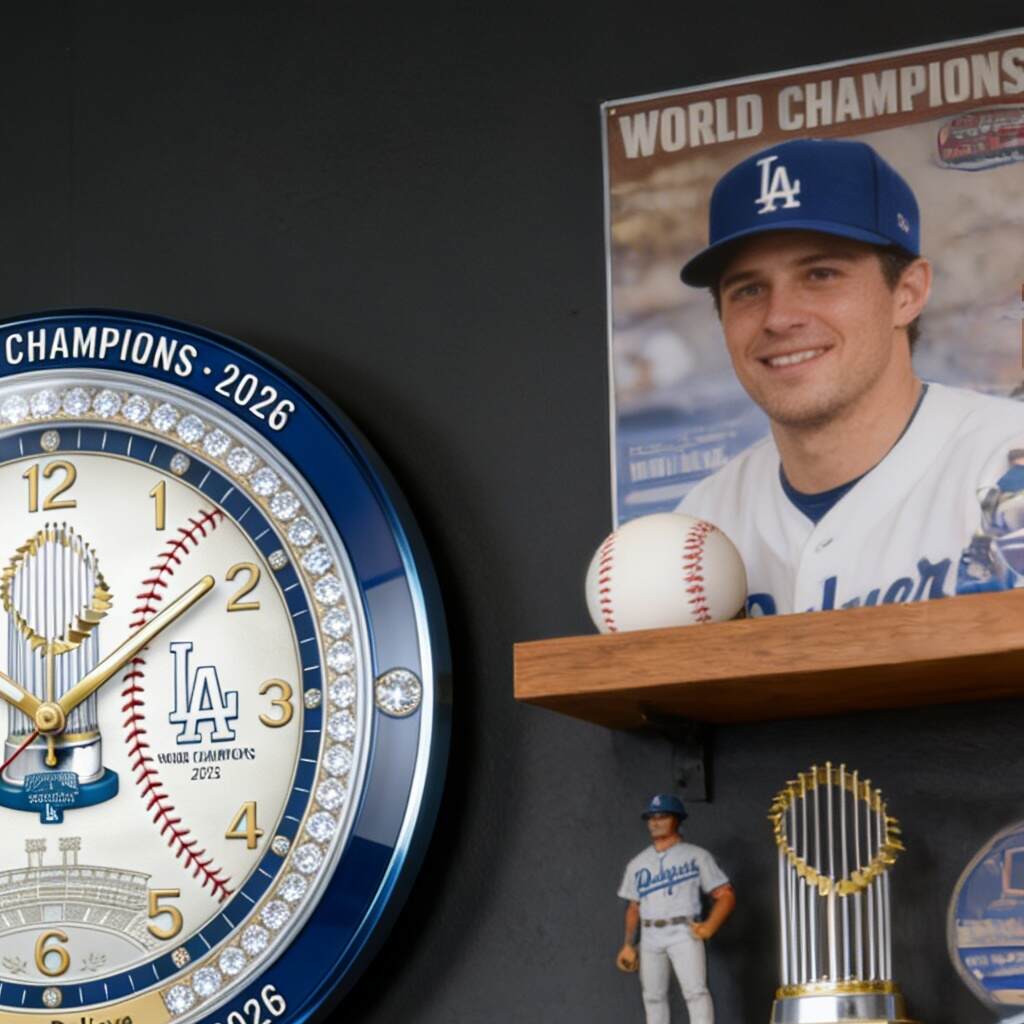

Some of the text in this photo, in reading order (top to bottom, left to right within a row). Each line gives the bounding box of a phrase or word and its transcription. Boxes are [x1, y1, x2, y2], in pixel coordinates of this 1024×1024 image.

[619, 48, 1024, 158] WORLD CHAMPIONS
[755, 155, 801, 214] LA
[5, 326, 198, 377] CHAMPIONS
[215, 364, 295, 431] 2026
[22, 460, 77, 513] 12
[149, 480, 166, 531] 1
[226, 562, 260, 612] 2
[169, 641, 239, 745] LA
[258, 678, 294, 729] 3
[225, 801, 263, 850] 4
[147, 888, 184, 941] 5
[34, 929, 71, 977] 6
